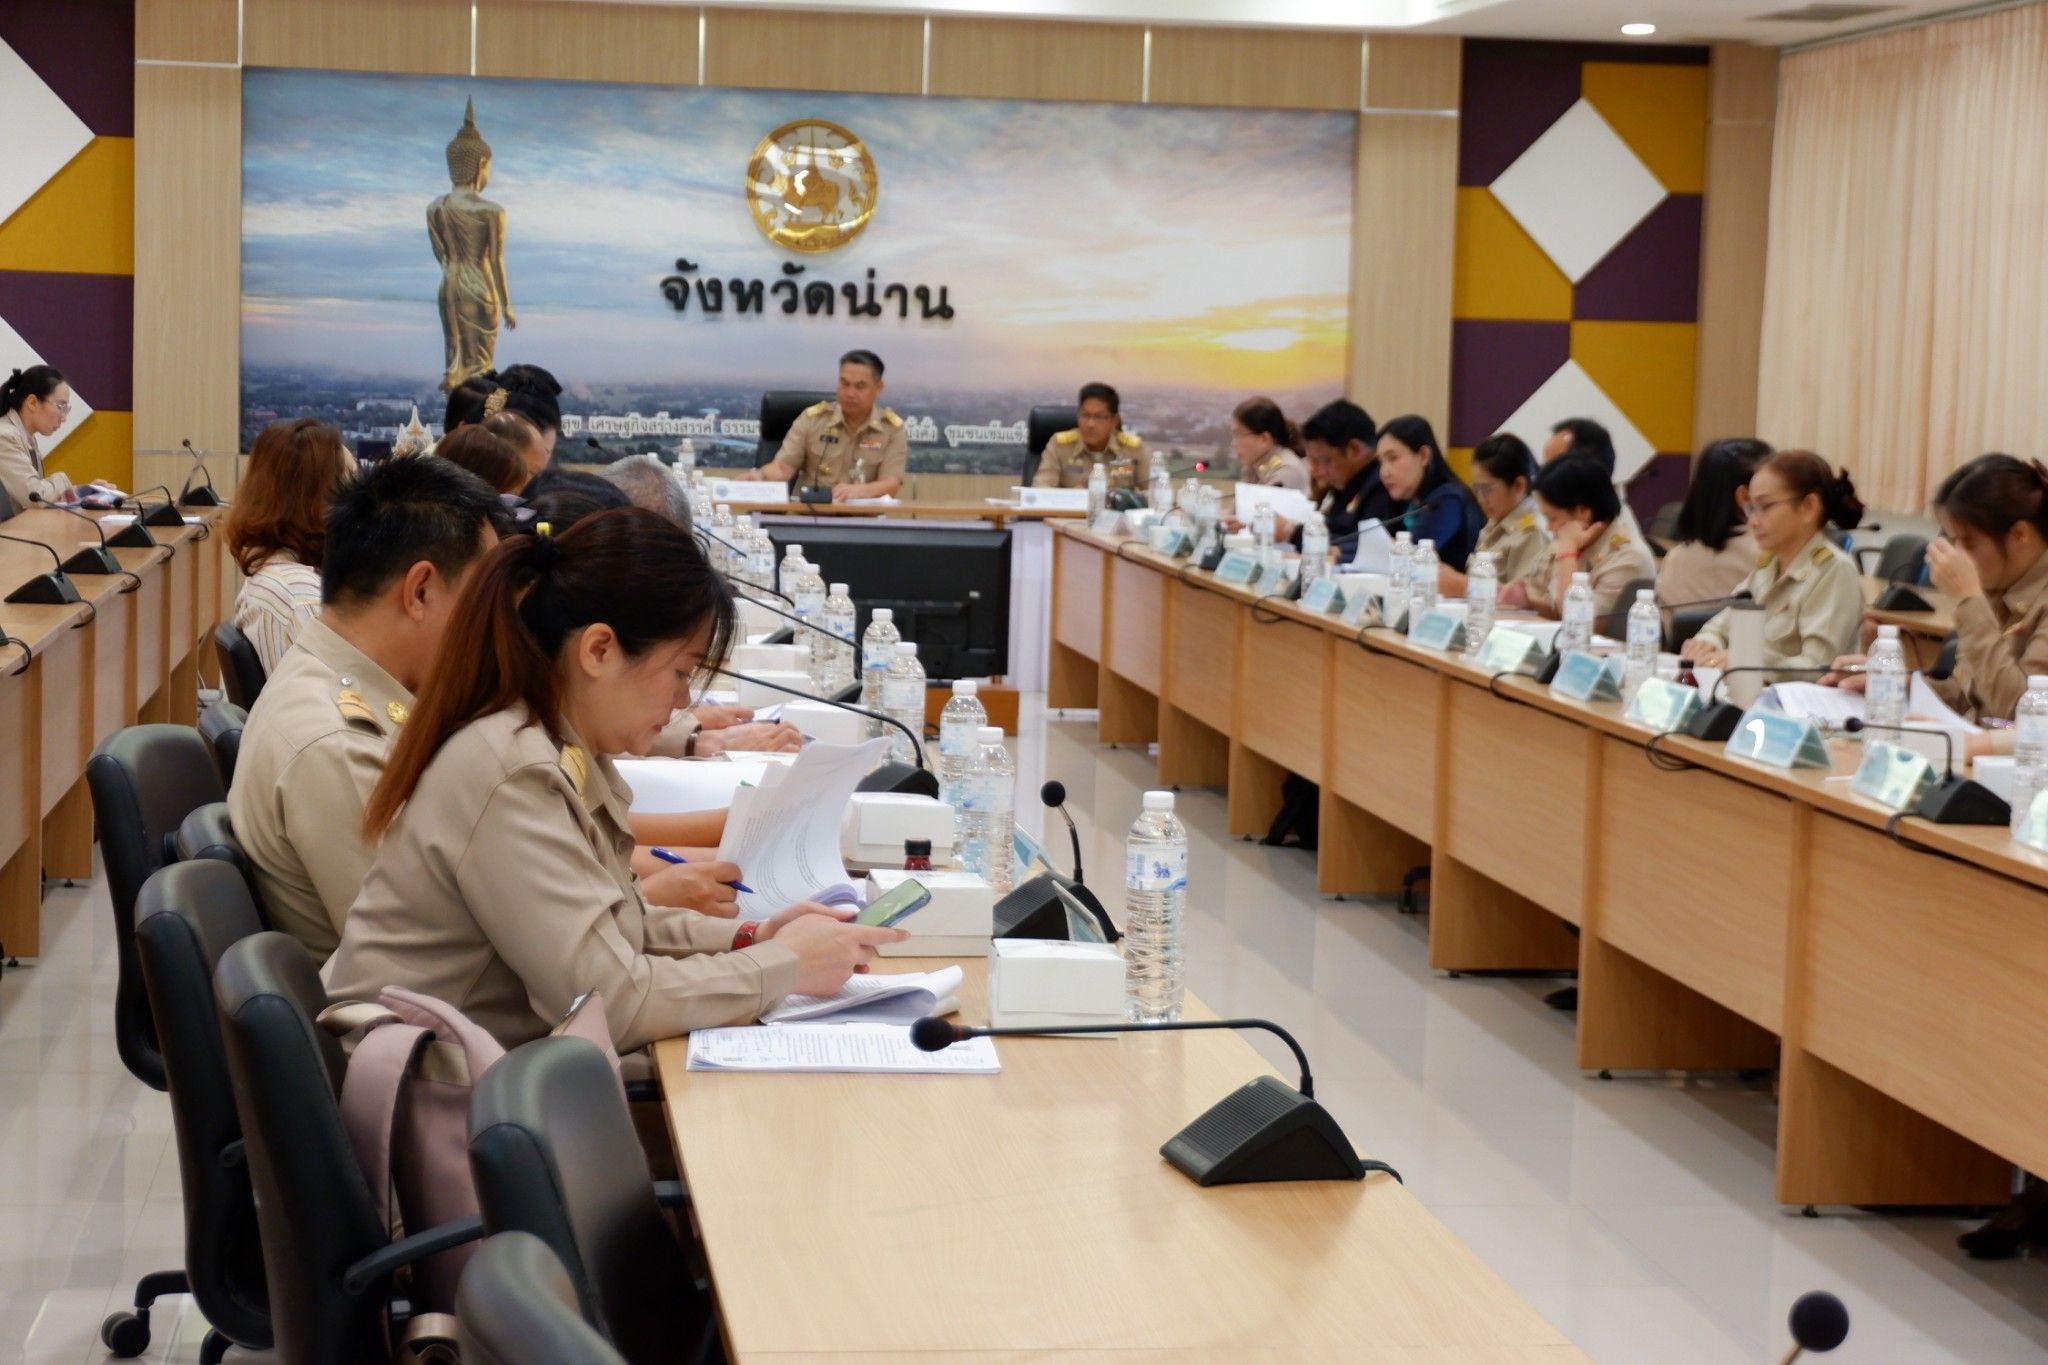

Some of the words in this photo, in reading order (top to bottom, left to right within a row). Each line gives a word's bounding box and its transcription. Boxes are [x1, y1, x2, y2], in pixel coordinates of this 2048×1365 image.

[660, 258, 954, 319] จังหวัดน่าน
[590, 413, 713, 437] เศรษฐกิจสร้างสรรค์
[946, 421, 1027, 445] ชุมชนเข้มแข็
